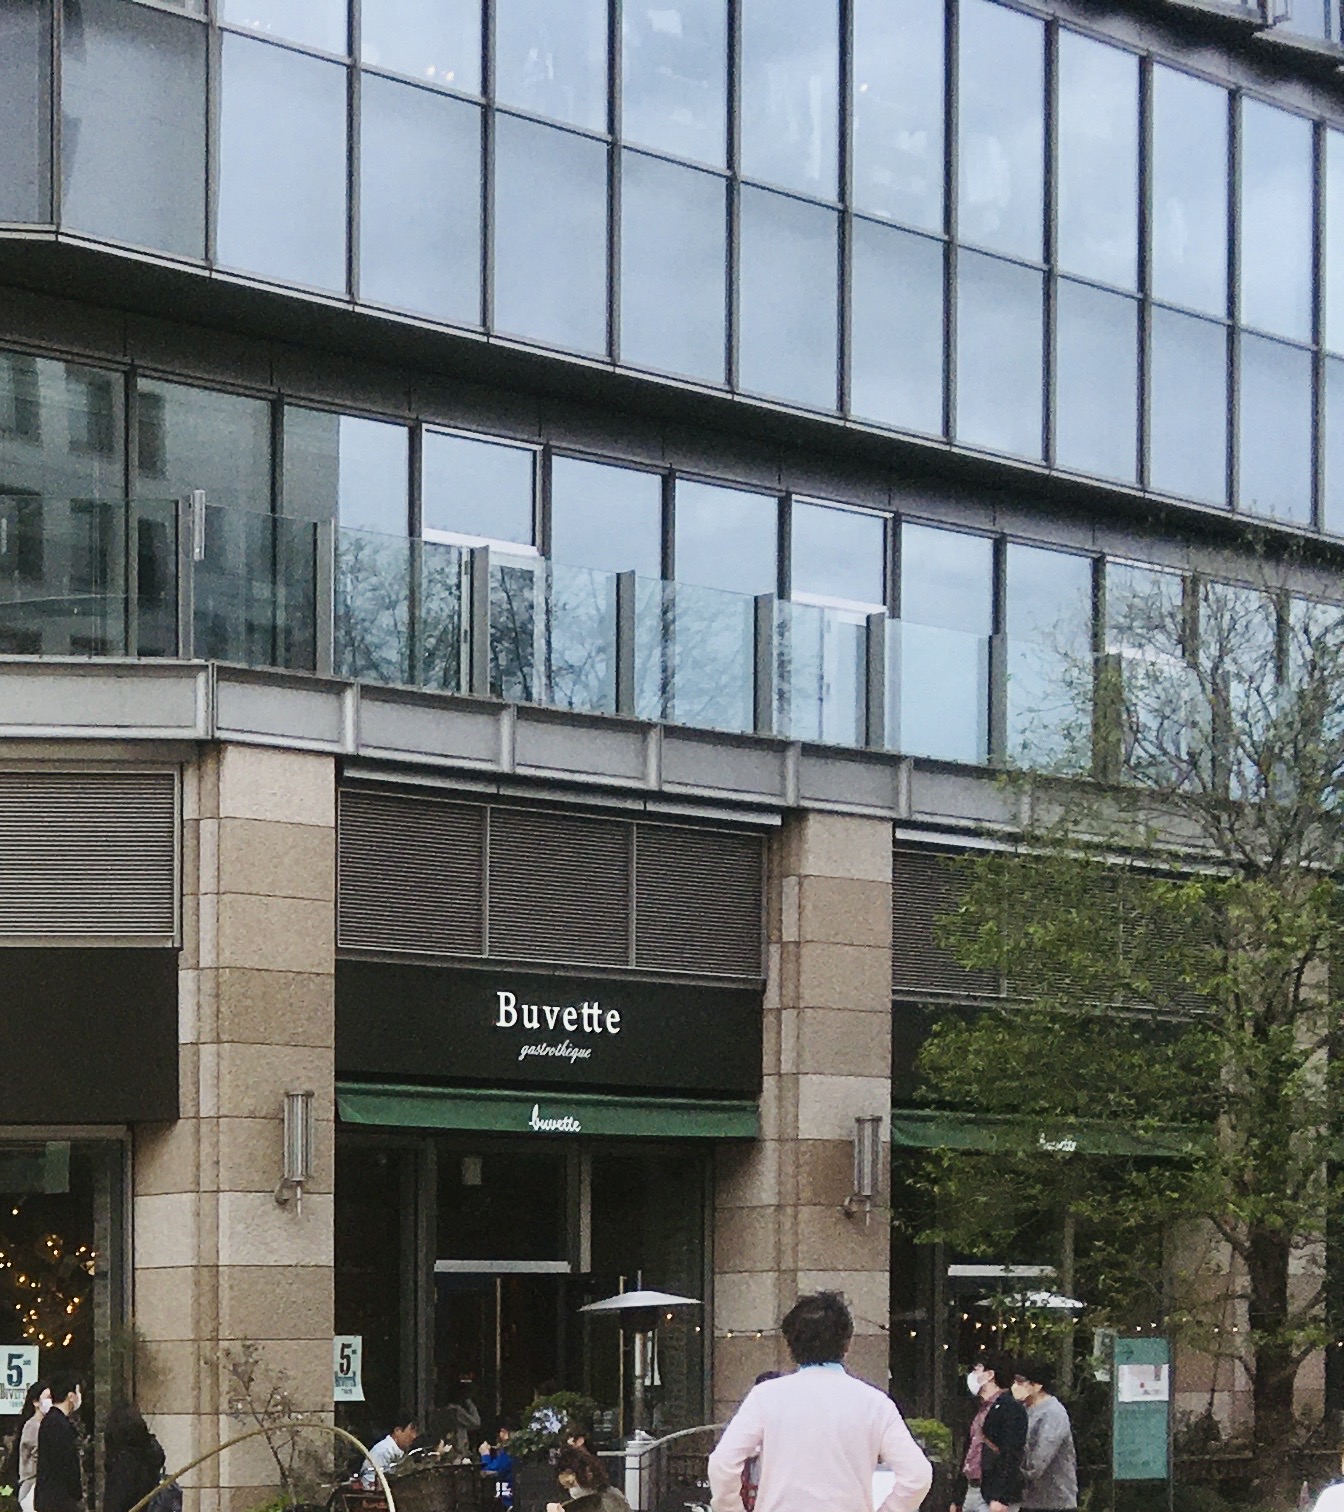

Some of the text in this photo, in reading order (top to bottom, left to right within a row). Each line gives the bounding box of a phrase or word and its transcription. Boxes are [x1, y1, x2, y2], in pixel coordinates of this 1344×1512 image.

[495, 991, 621, 1034] Buvette
[528, 1103, 582, 1132] buvette
[7, 1353, 24, 1387] 5
[339, 1343, 353, 1375] 5
